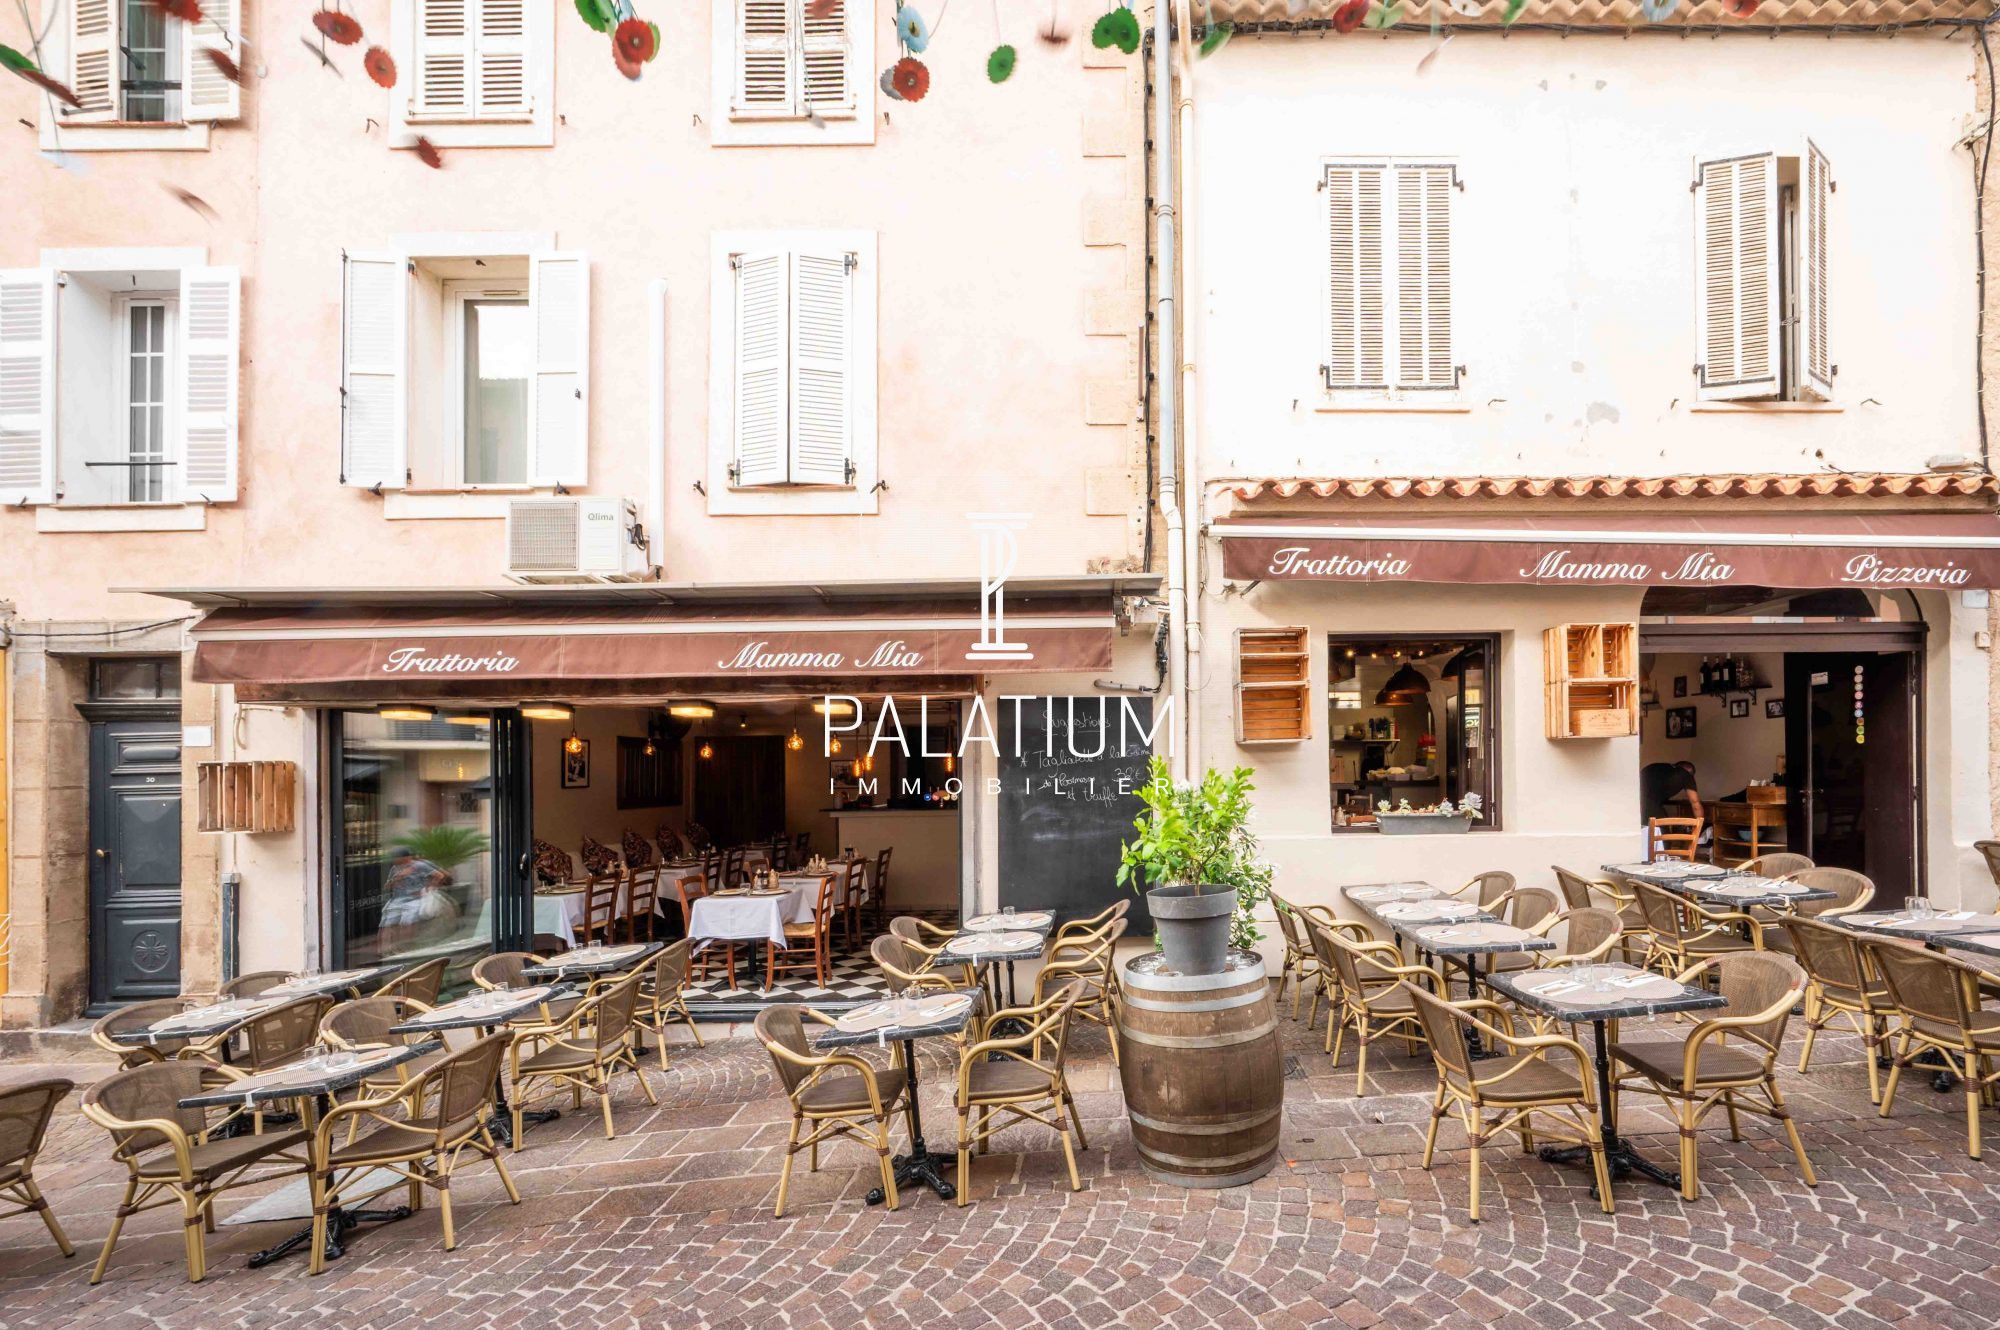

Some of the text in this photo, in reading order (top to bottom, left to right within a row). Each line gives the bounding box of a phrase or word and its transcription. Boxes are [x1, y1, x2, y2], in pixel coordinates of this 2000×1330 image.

[587, 512, 614, 521] Qlima
[1268, 546, 1972, 586] Trattoria Mamma Mia Pizzeria
[381, 639, 924, 674] Trattoria Mamma Mia
[1040, 710, 1112, 738] Sugestios
